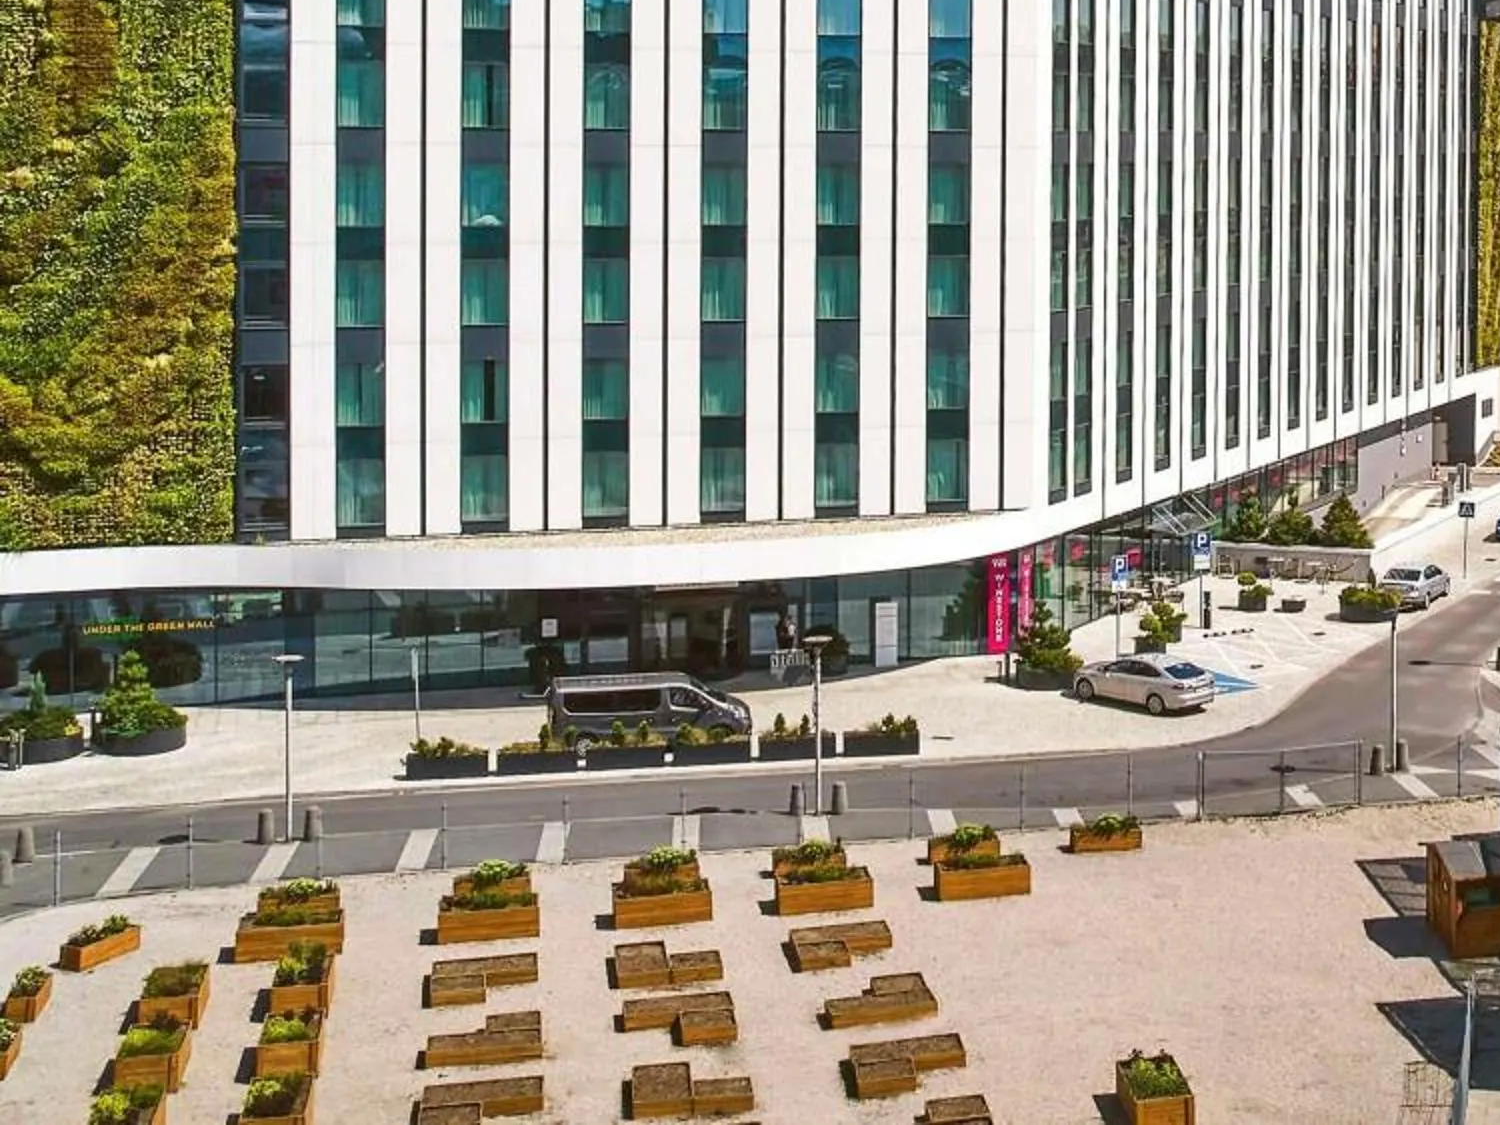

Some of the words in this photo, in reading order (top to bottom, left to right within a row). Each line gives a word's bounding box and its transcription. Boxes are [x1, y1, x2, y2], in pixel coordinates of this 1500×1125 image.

[1197, 534, 1207, 548] P
[1116, 558, 1125, 573] P
[83, 624, 121, 635] UNDER
[124, 624, 143, 633] THE
[147, 621, 185, 632] GREEN
[187, 619, 215, 629] WALL
